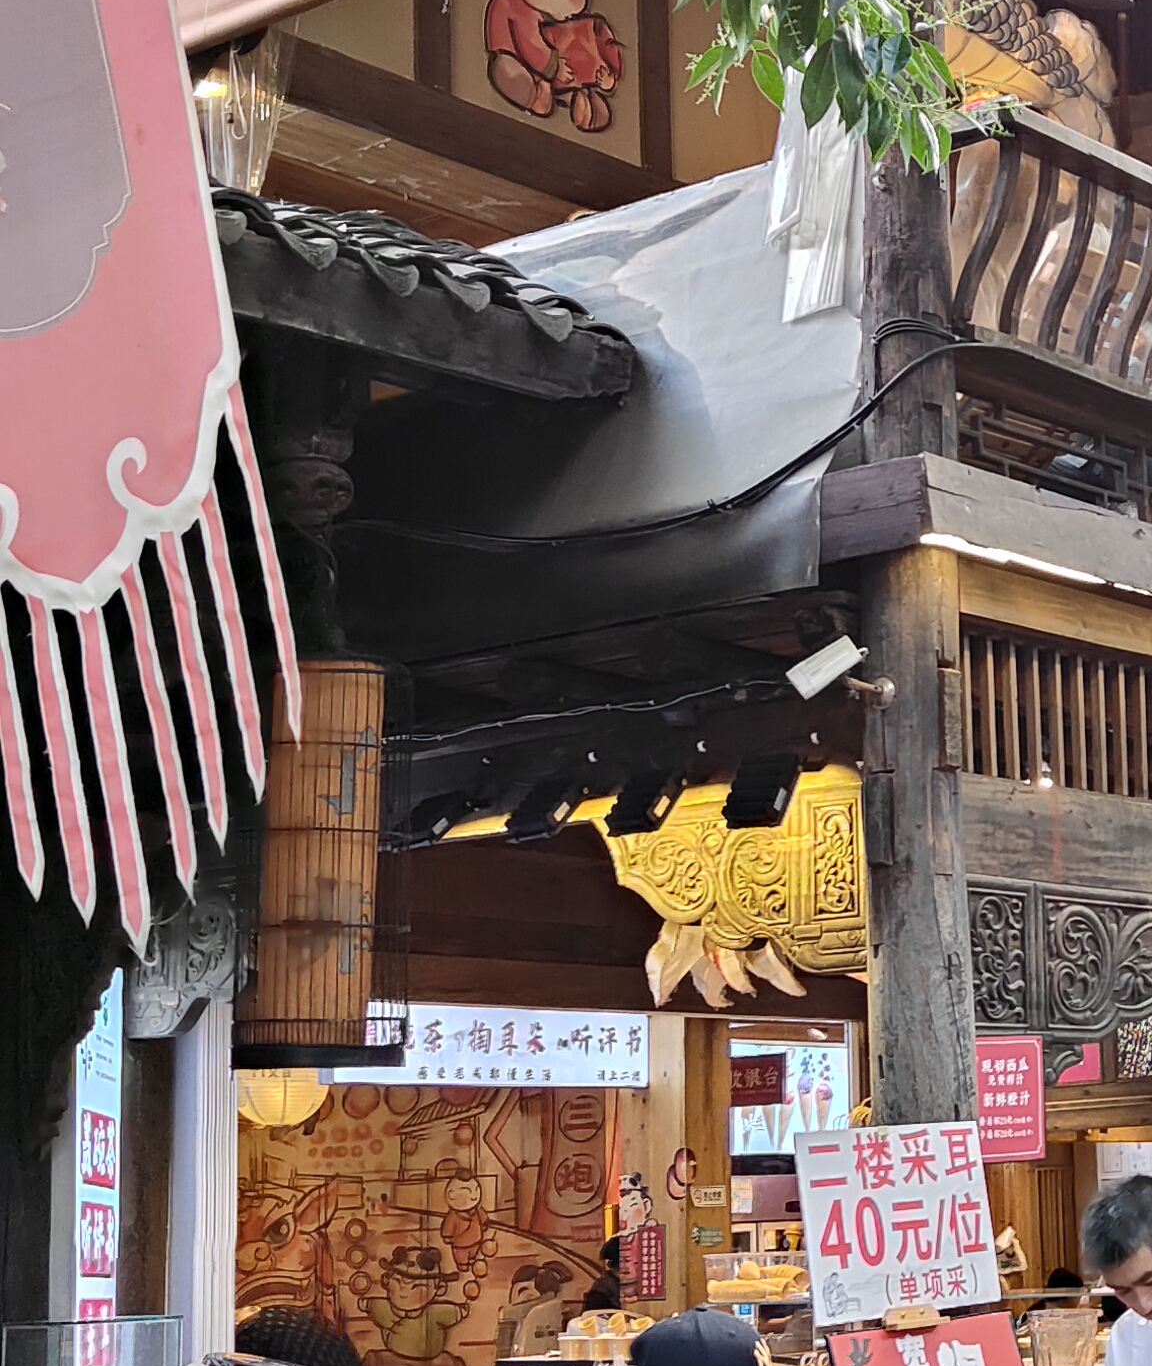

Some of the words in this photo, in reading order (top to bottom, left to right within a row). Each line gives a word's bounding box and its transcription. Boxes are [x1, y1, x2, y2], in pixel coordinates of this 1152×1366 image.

[467, 1019, 546, 1056] 掏耳朵
[570, 1024, 642, 1056] 听评书
[808, 1127, 977, 1191] 二楼采耳
[819, 1191, 989, 1271] 40元/位
